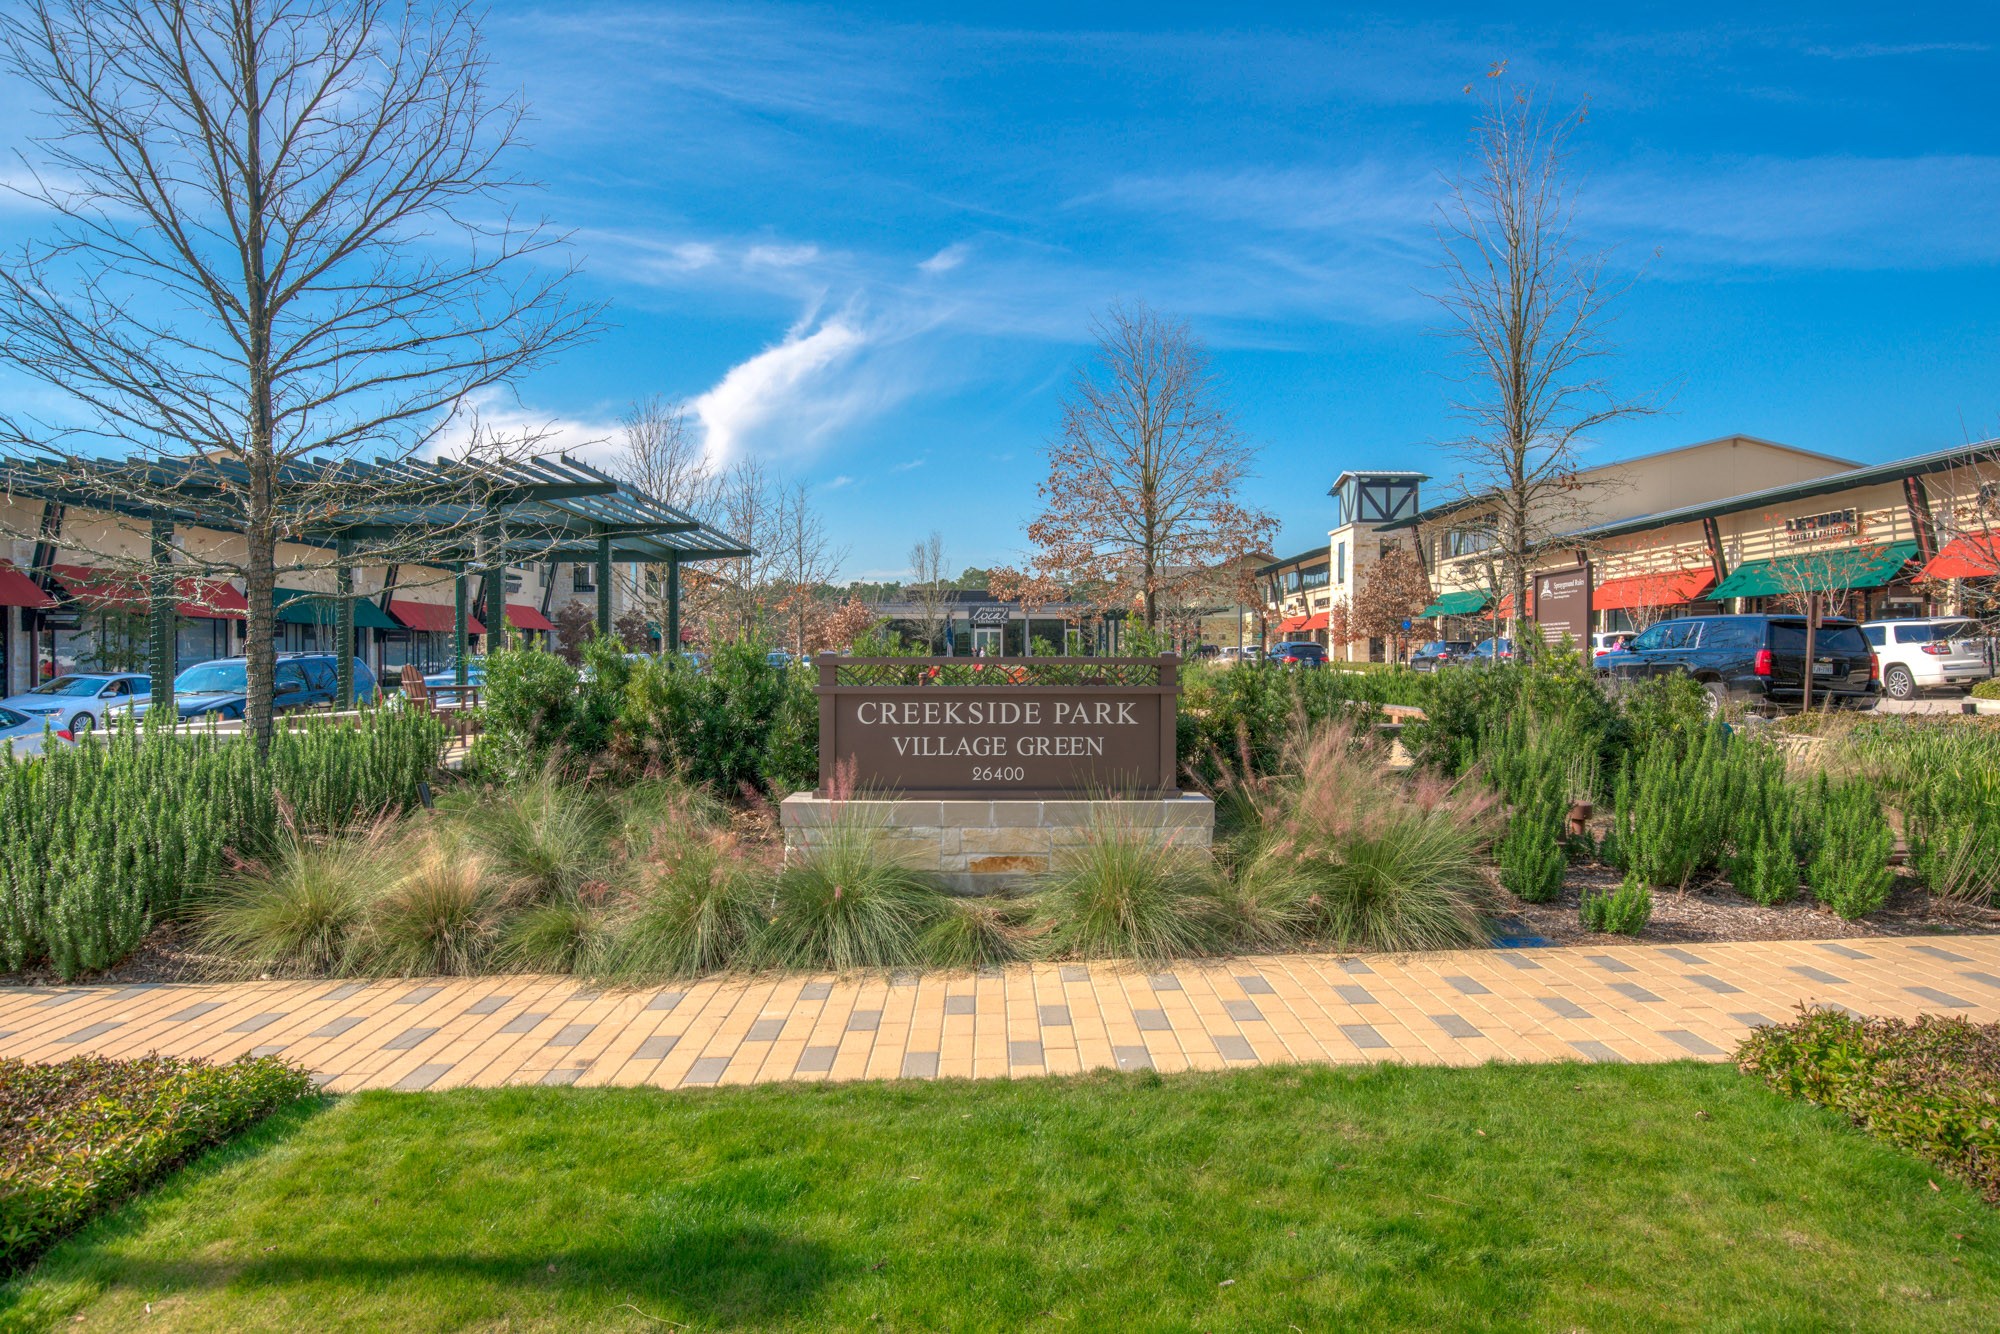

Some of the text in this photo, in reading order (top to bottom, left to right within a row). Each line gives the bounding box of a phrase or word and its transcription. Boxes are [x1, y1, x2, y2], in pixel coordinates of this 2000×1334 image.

[857, 702, 1139, 725] CREEKSIDE PARK
[892, 736, 1104, 756] VILLAGE GREEN
[972, 766, 1025, 781] 26400
